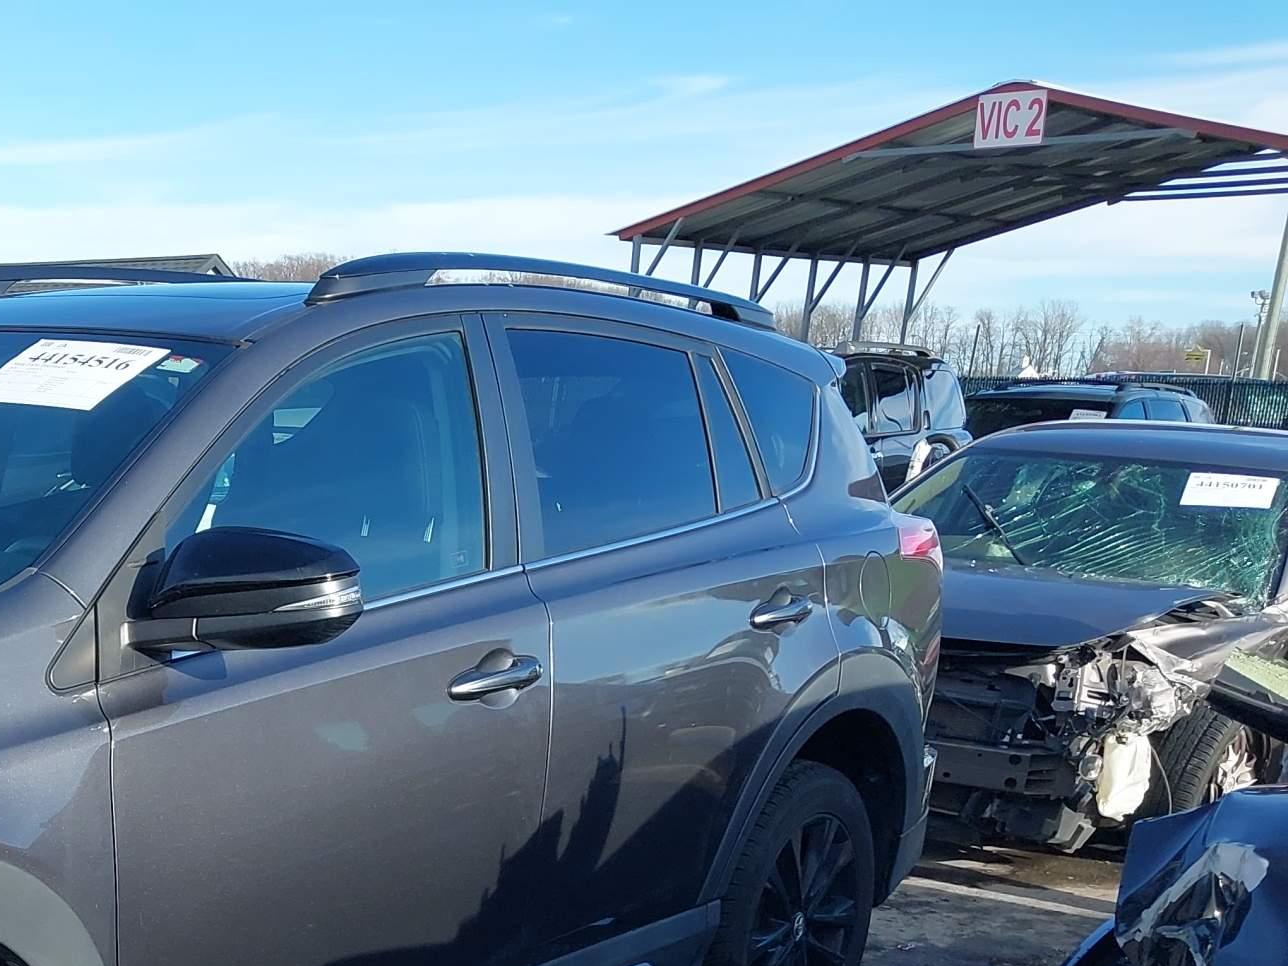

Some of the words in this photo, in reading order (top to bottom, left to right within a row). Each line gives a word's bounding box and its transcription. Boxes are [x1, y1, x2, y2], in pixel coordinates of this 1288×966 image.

[979, 99, 1021, 141] VIC
[1025, 97, 1044, 137] 2
[28, 351, 135, 371] 44154516
